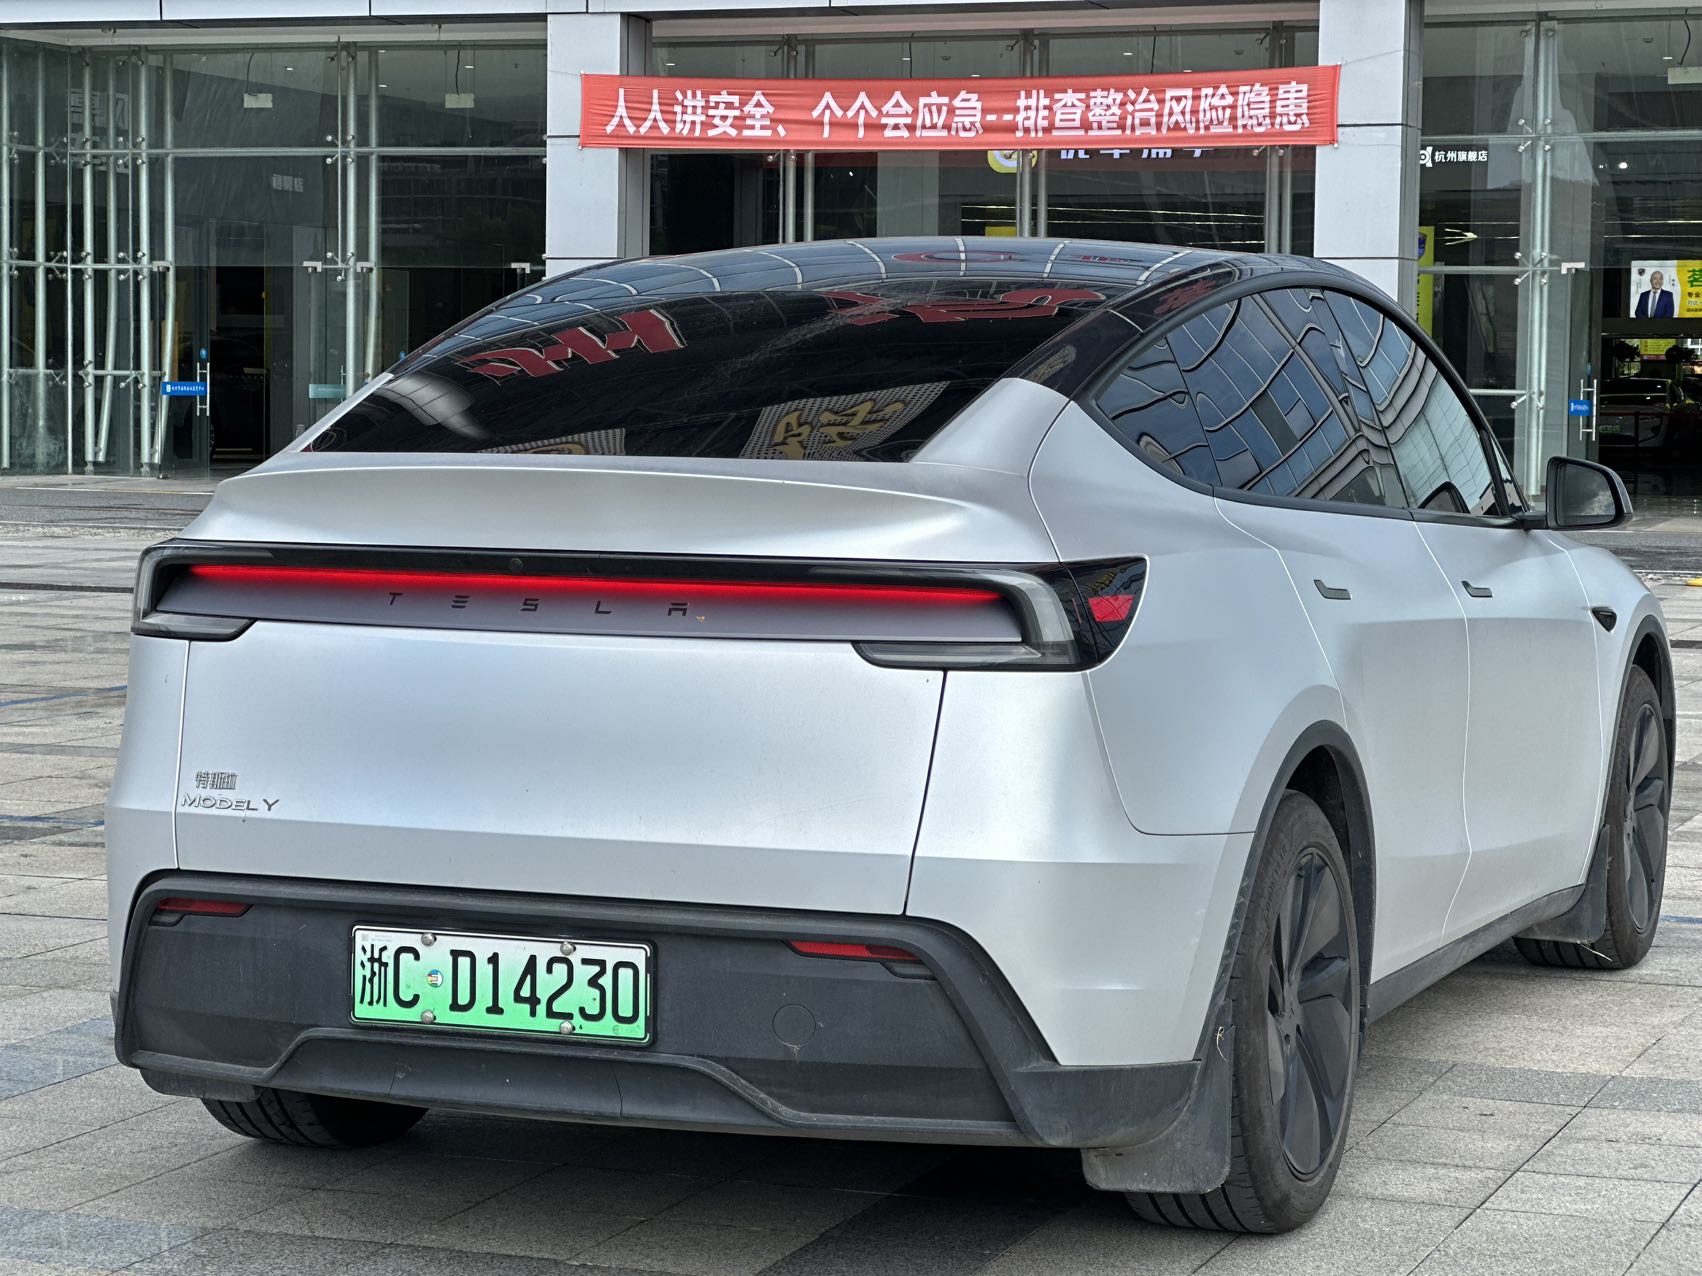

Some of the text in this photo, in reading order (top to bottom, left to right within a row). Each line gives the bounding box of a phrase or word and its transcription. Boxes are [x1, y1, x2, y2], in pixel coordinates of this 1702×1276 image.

[1434, 150, 1488, 162] 杭州旗舰店
[388, 592, 688, 617] TESLA
[195, 770, 238, 790] 特斯拉
